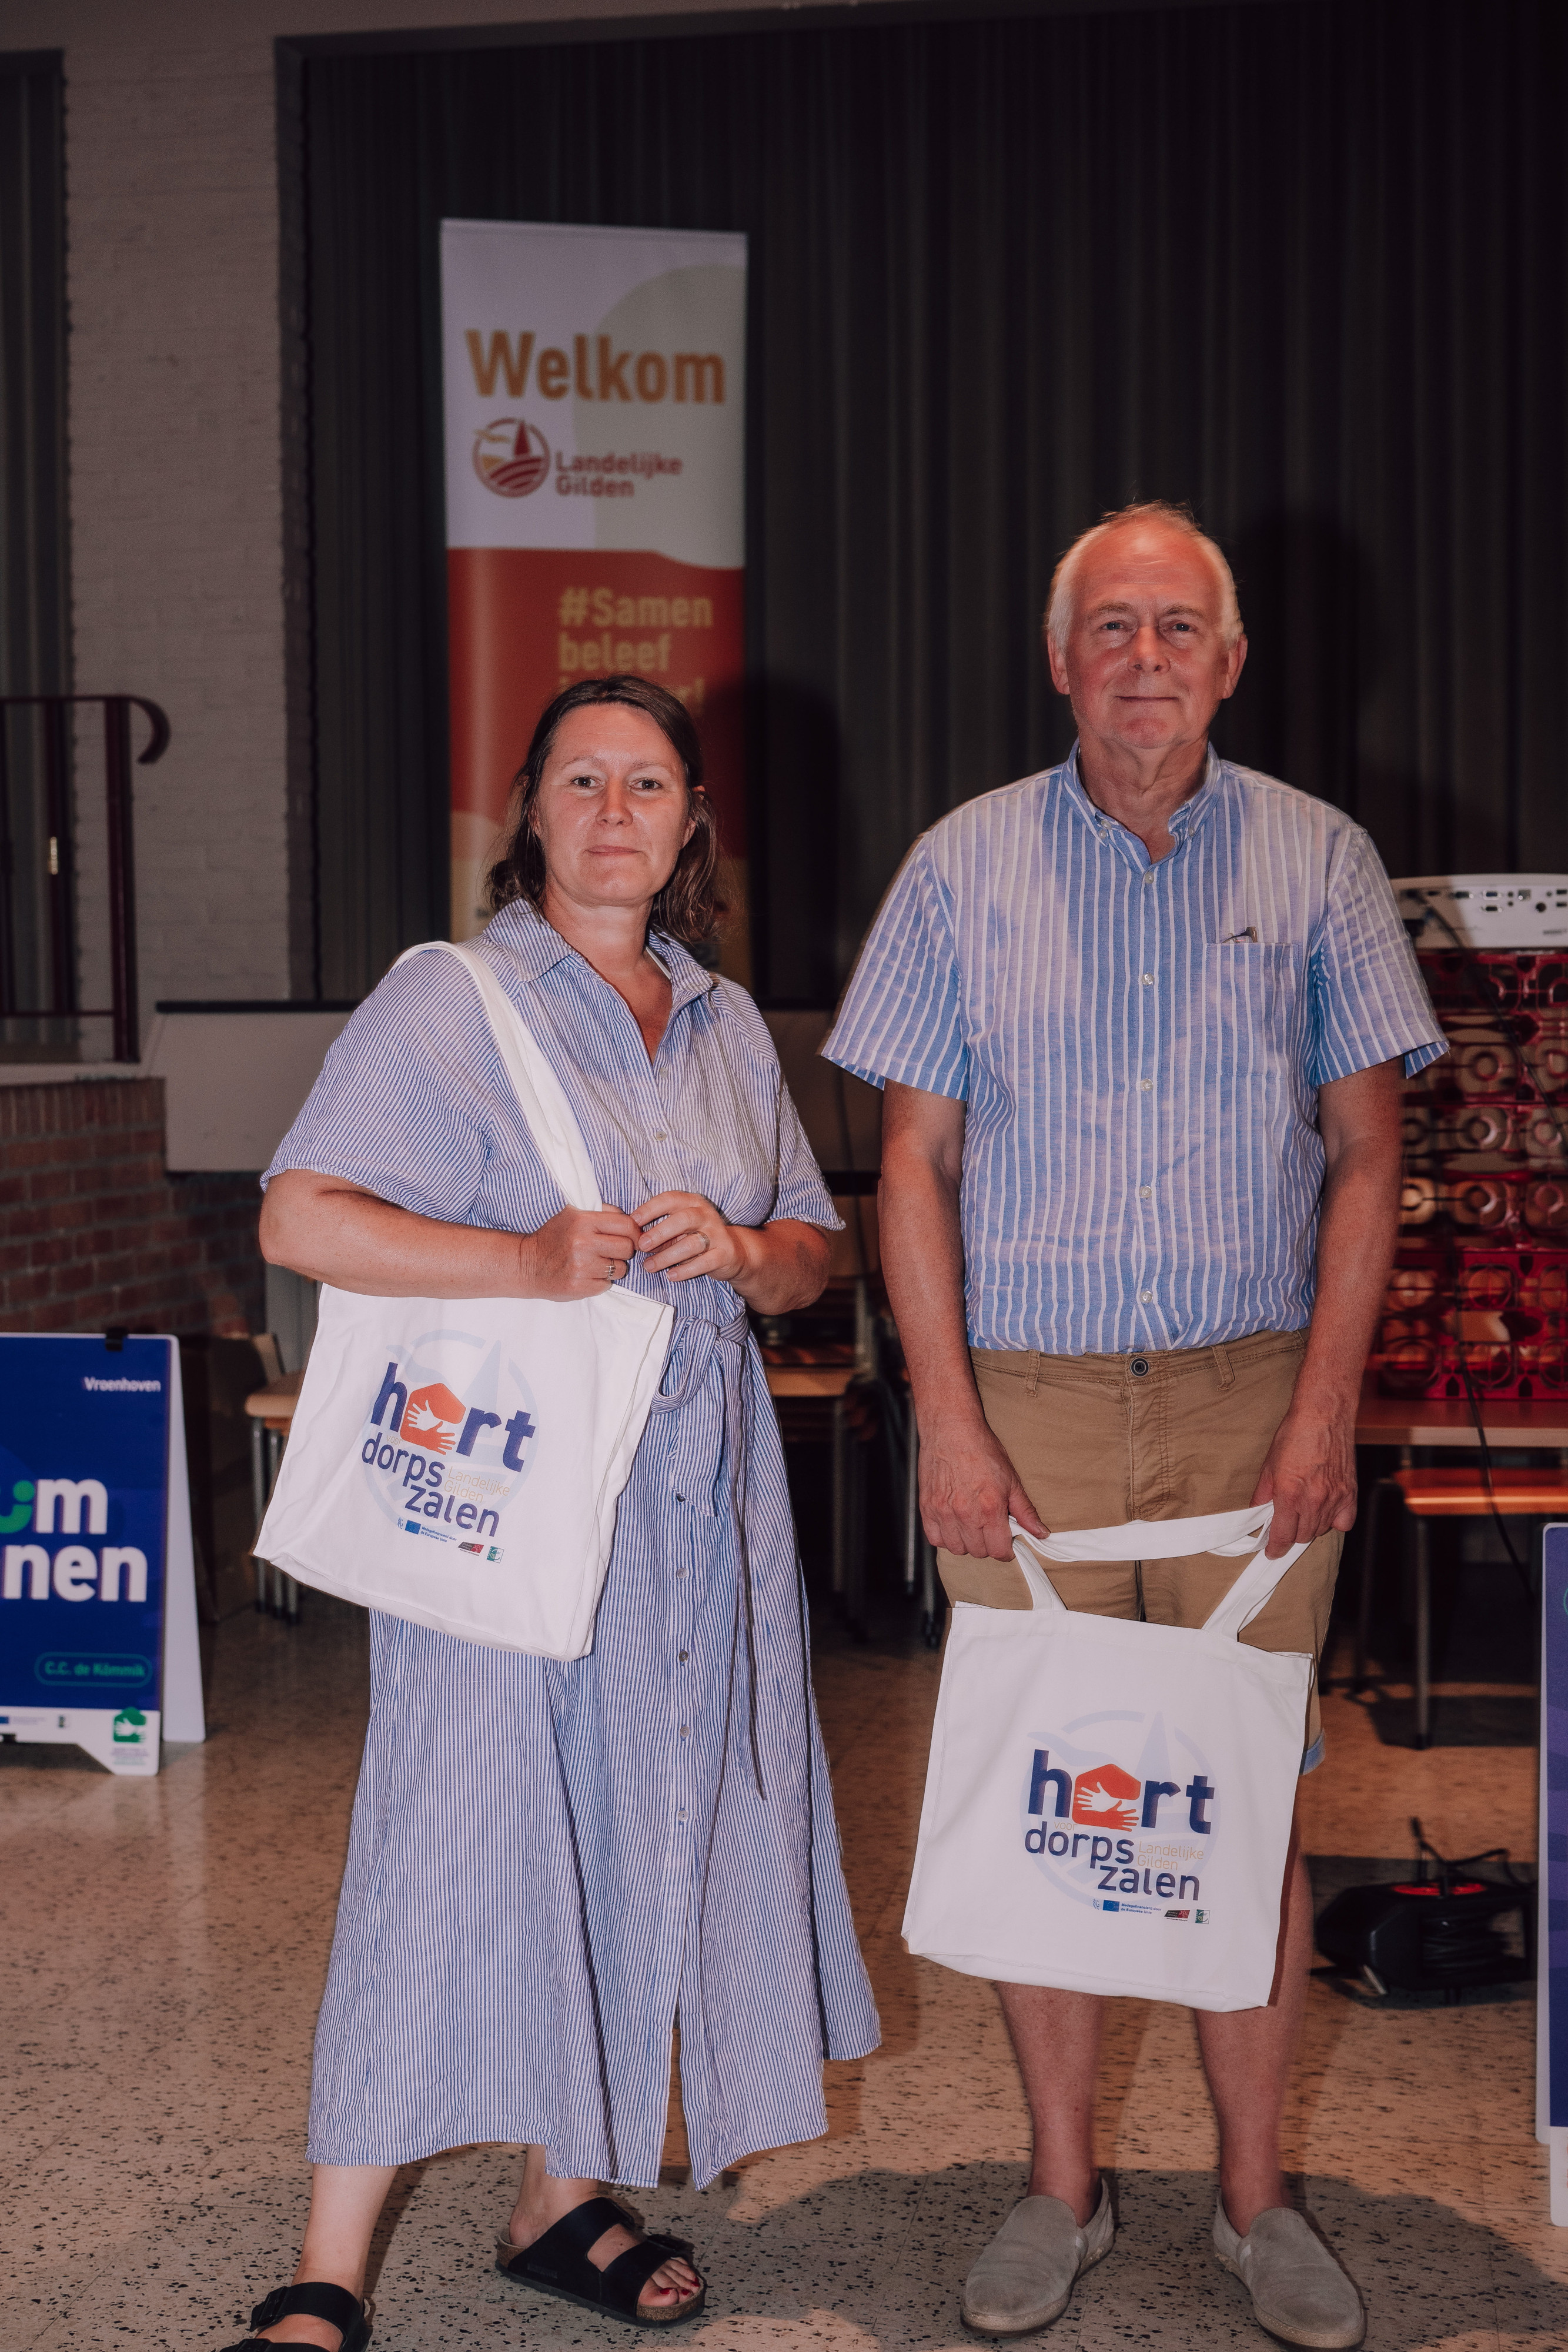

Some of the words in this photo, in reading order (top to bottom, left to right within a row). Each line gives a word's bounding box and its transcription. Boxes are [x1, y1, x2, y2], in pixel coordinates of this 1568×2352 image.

[464, 329, 727, 405] Welkom
[555, 451, 683, 480] Landelijke
[555, 475, 635, 497] Gilden
[559, 588, 713, 629] #Samen
[559, 632, 672, 672] beleef
[84, 1376, 161, 1392] Vroenhoven
[387, 1434, 403, 1446] voor
[362, 1432, 445, 1487] dorps
[444, 1480, 483, 1502] Gilden
[448, 1466, 510, 1496] Landelijke
[404, 1484, 499, 1537] zalen
[1054, 1822, 1078, 1831] voor
[1025, 1821, 1135, 1869] dorps
[1138, 1841, 1204, 1860] Landelijke
[1137, 1854, 1178, 1870] Gilden
[1098, 1865, 1200, 1900] zalen
